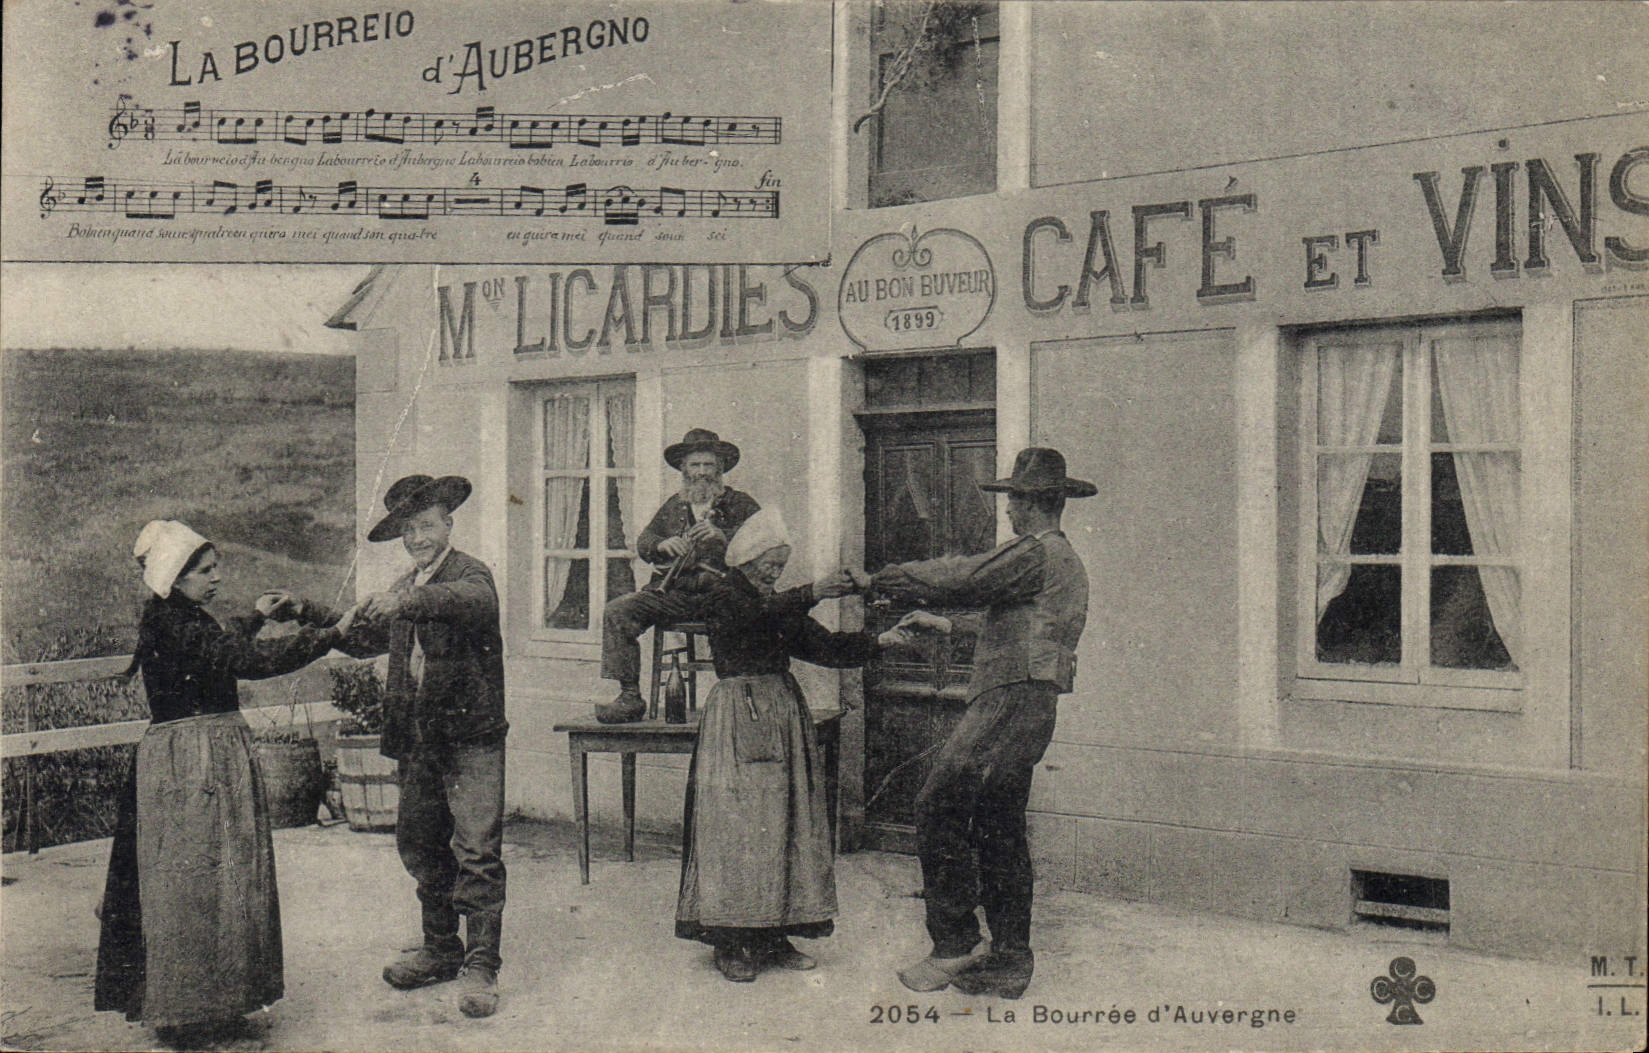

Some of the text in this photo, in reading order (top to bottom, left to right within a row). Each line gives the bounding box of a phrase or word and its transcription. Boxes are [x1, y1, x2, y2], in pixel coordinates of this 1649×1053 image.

[1022, 175, 1258, 315] CAFÉ
[1303, 230, 1380, 291] ET
[513, 264, 820, 359] LICARDIES
[846, 269, 993, 303] AU BON BUVEUR
[892, 311, 936, 332] 1899
